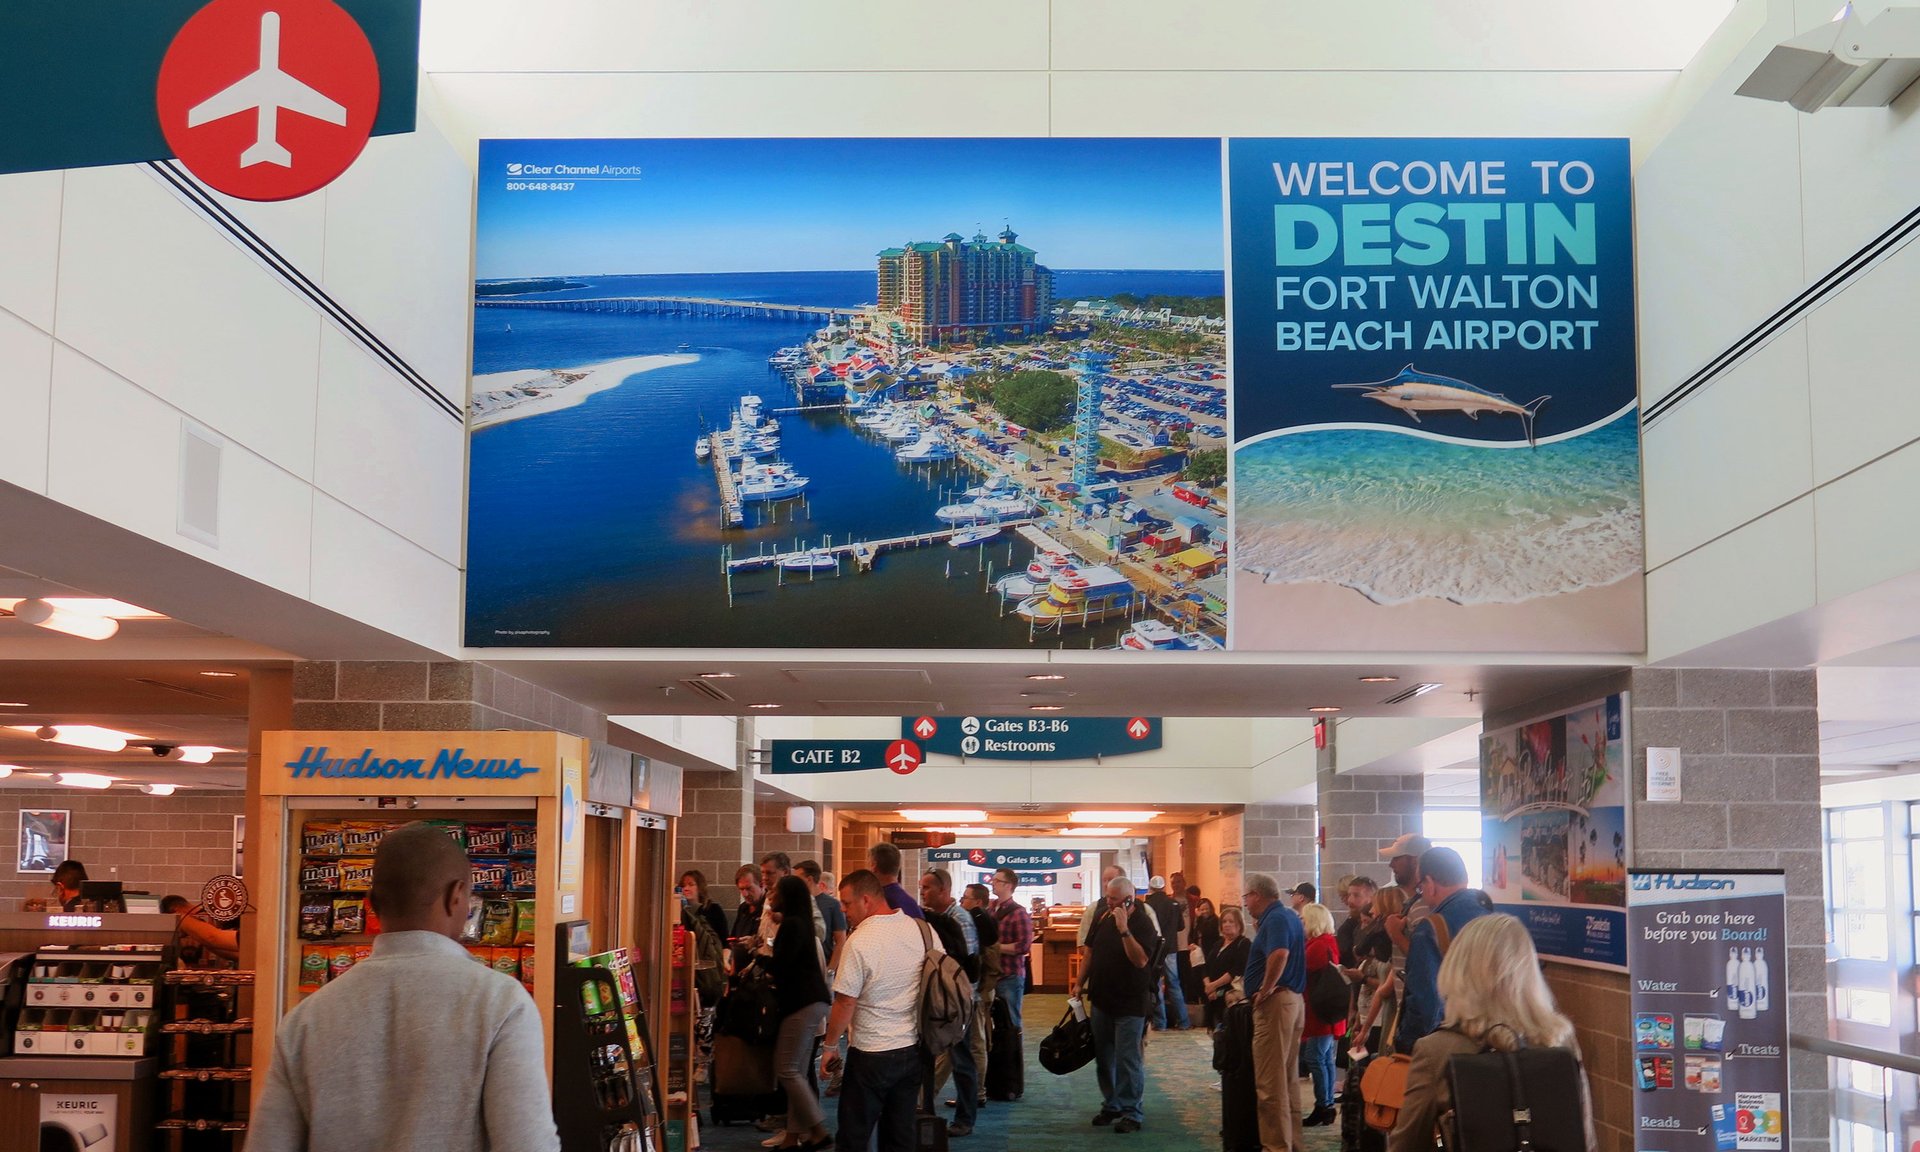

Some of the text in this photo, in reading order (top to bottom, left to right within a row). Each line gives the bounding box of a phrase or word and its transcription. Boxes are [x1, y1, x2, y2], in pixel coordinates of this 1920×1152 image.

[523, 164, 642, 176] Clear Channel Airports
[1272, 160, 1596, 196] WELCOME TO
[506, 182, 575, 191] 800-648-8437
[1273, 201, 1597, 267] DESTIN
[1276, 274, 1598, 311] FORT WALTON
[1276, 319, 1599, 352] BEACH AIRPORT
[984, 719, 1069, 732] Gates B3-B6
[984, 739, 1056, 752] Restrooms
[284, 746, 540, 780] Hudson News
[791, 750, 861, 764] GATE B2
[1007, 856, 1052, 864] Gates B5-B6
[1654, 873, 1735, 890] Hudson
[207, 881, 243, 906] COFFEE HOUSE
[48, 915, 102, 928] KEURIG
[1655, 911, 1755, 925] Grab one here
[1644, 927, 1767, 944] before you Board!
[1637, 980, 1678, 991] Water
[1738, 1043, 1780, 1055] Treats
[56, 1101, 99, 1109] KEURIG
[1641, 1116, 1680, 1128] Reads
